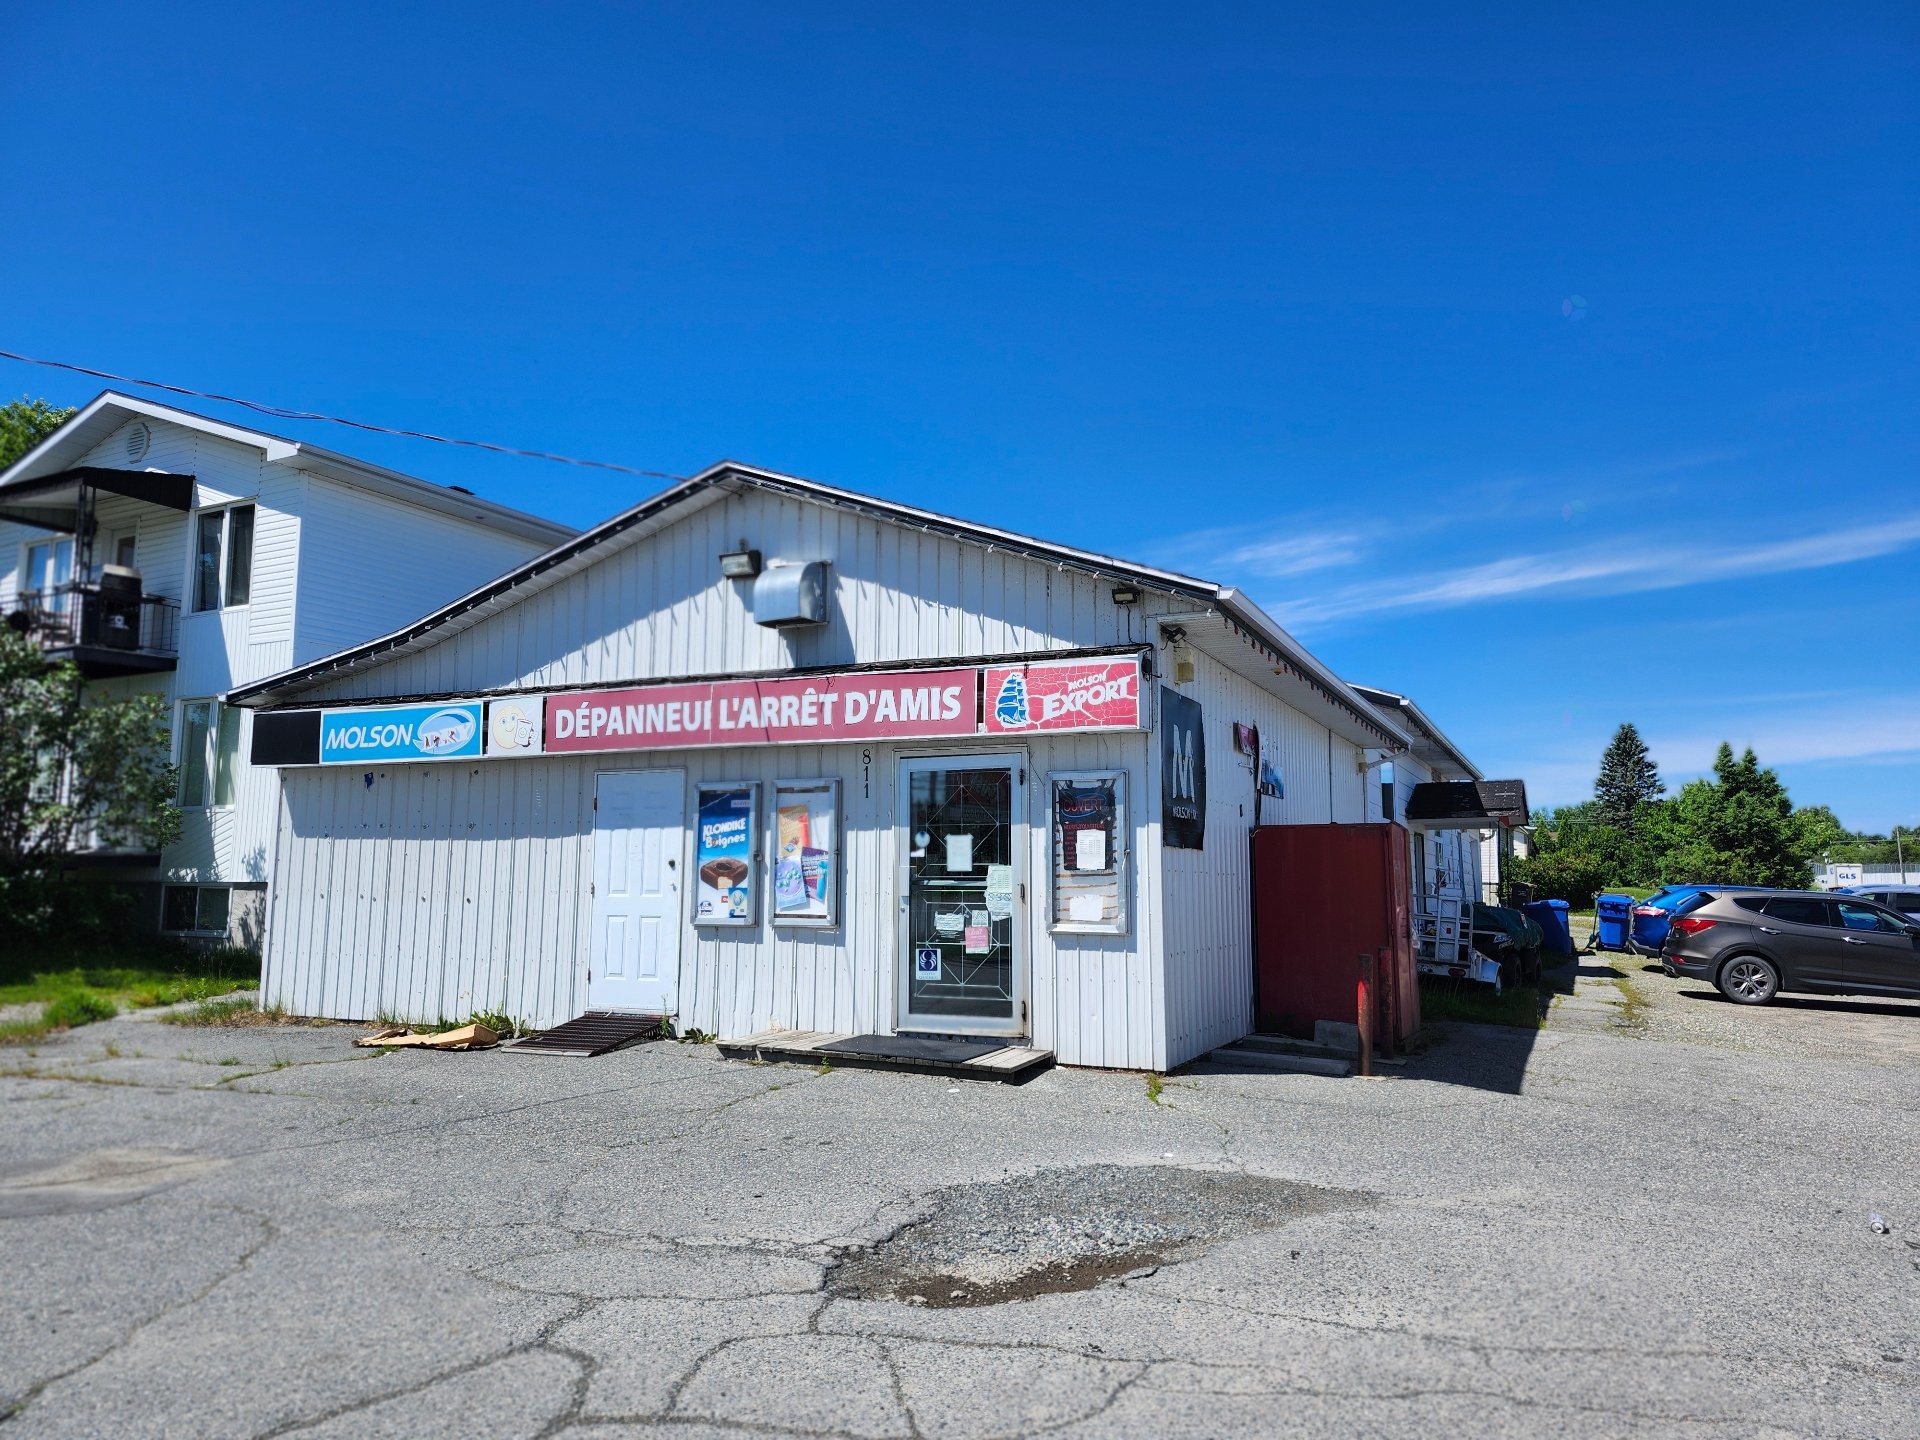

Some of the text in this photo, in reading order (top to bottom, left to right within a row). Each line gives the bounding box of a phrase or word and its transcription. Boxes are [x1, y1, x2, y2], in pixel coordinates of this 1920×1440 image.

[1068, 671, 1107, 692] MOLSON
[719, 687, 839, 730] L'ARRÊT
[844, 686, 962, 725] D'AMIS
[1043, 676, 1131, 720] EXPORT
[325, 723, 414, 750] MOLSON
[862, 748, 872, 799] 811
[1063, 798, 1104, 812] OUVERT
[702, 817, 746, 841] KLONDIKE
